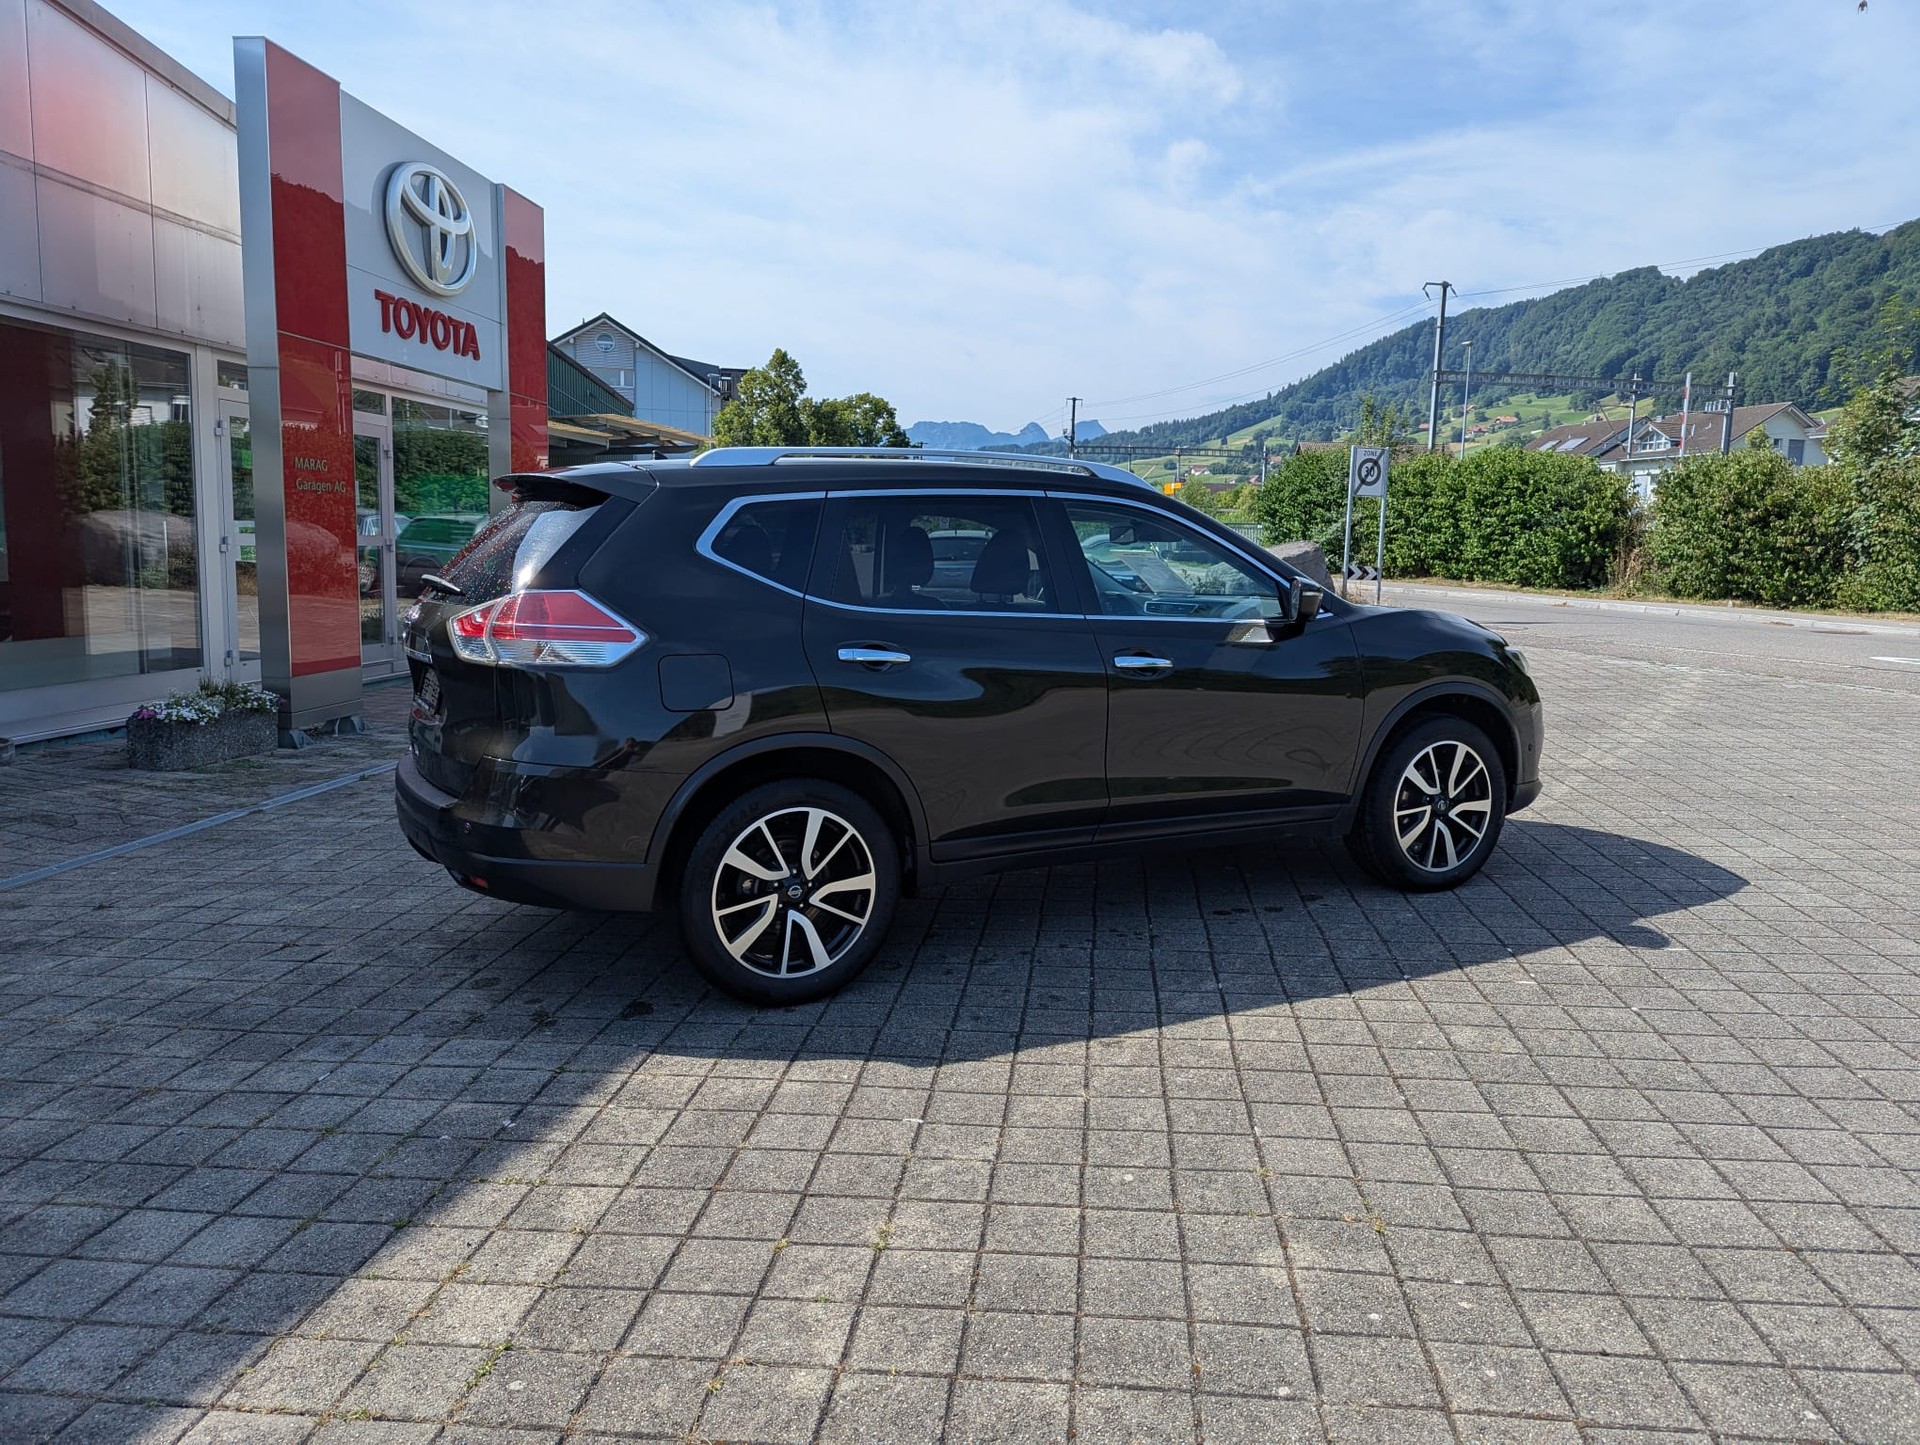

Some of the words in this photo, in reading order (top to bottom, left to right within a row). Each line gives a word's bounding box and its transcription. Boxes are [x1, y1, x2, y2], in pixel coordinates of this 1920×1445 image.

[374, 288, 481, 361] TOYOTA
[294, 456, 328, 472] MARAG
[1364, 466, 1375, 478] 30
[295, 477, 332, 495] Garagen
[334, 480, 346, 494] AG
